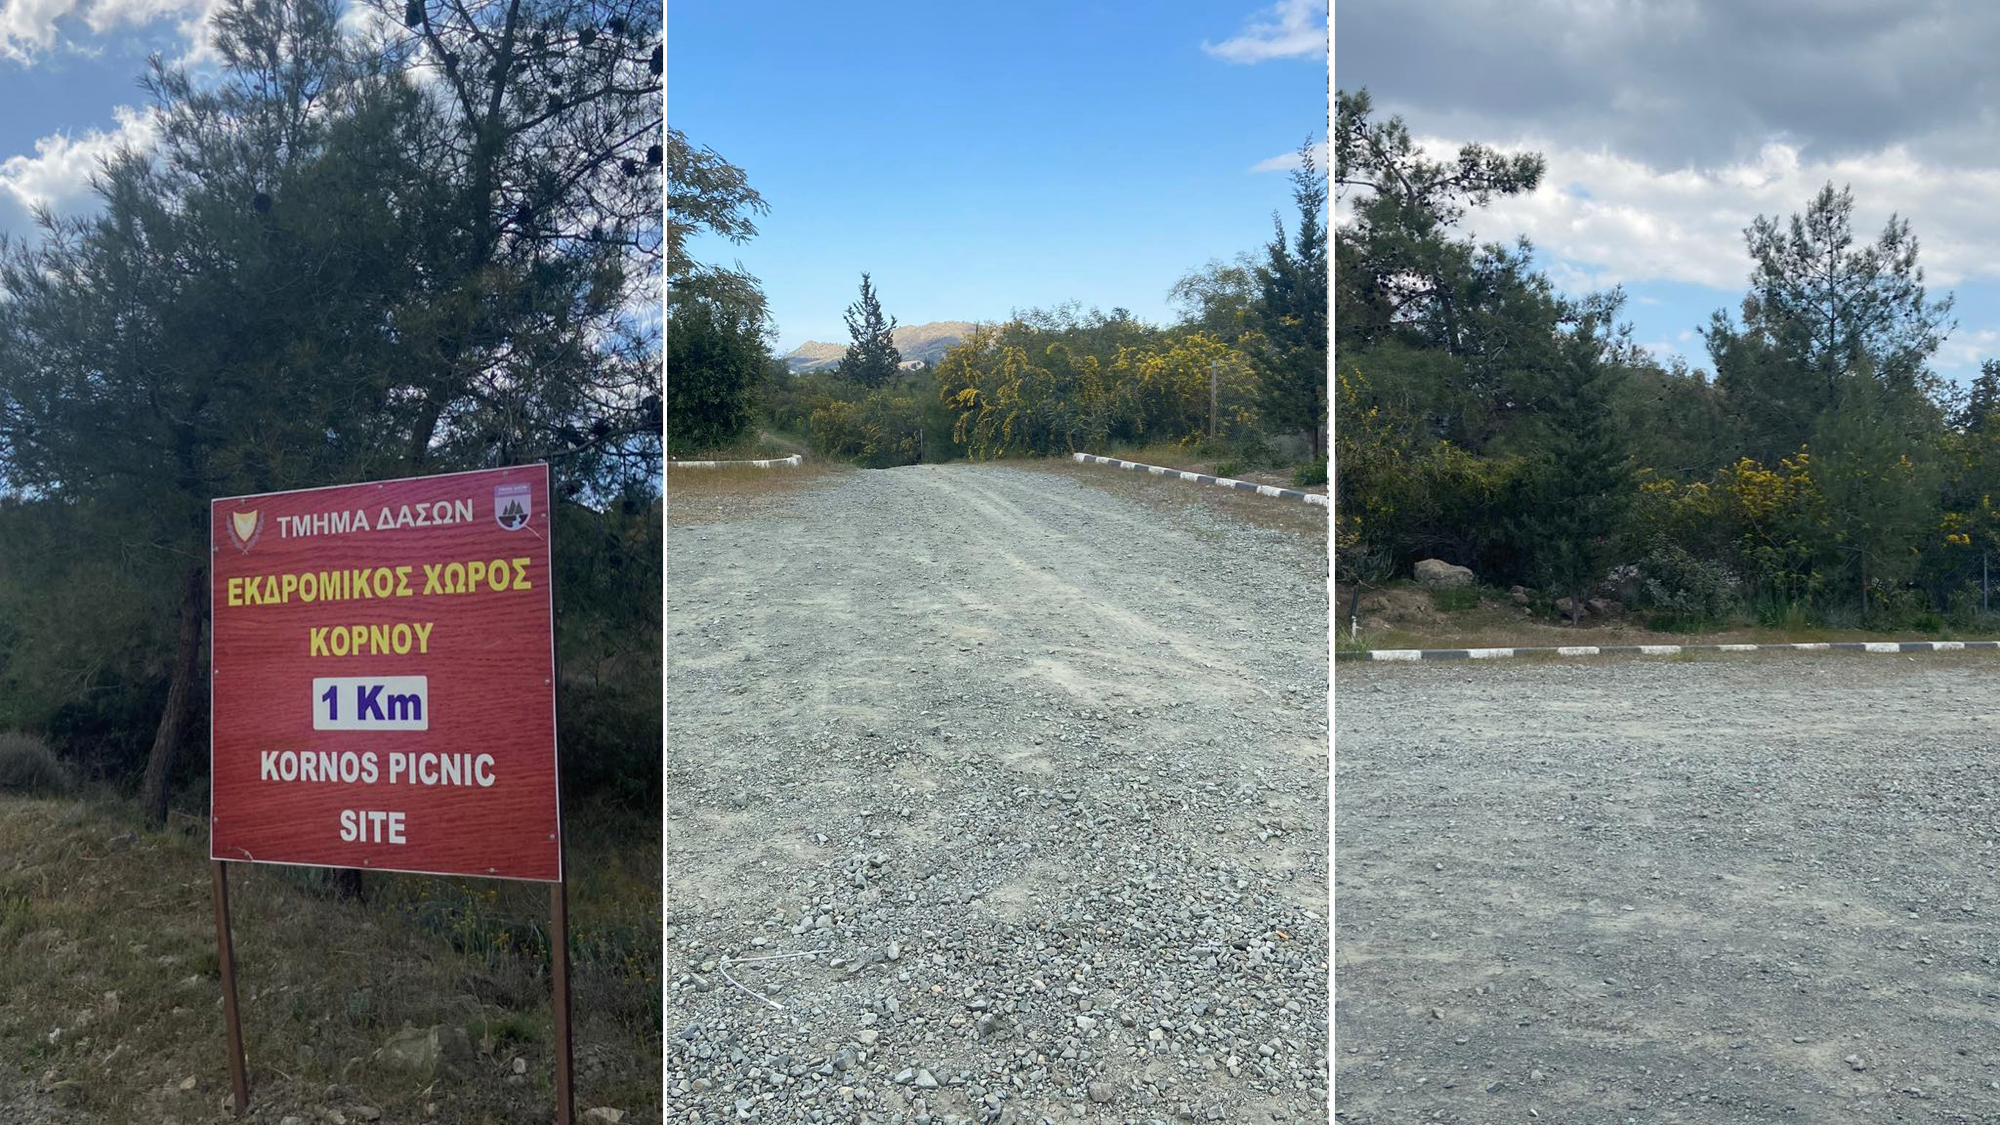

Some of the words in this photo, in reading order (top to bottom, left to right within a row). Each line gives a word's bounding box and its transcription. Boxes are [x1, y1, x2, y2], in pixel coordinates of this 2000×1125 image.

[276, 508, 370, 539] ΤΜΗΜΑ
[376, 499, 474, 531] ΔΑΣΩΝ
[227, 566, 414, 607] ΕΚΔΡΟΜΙΚΟΣ
[423, 557, 532, 596] ΧΩΡΟΣ
[309, 622, 434, 657] ΚΟΡΝΟΥ
[321, 685, 338, 721] 1
[356, 685, 422, 721] Km
[260, 750, 379, 784] KORNOS
[389, 752, 496, 787] PICNIC
[339, 809, 407, 845] SITE
